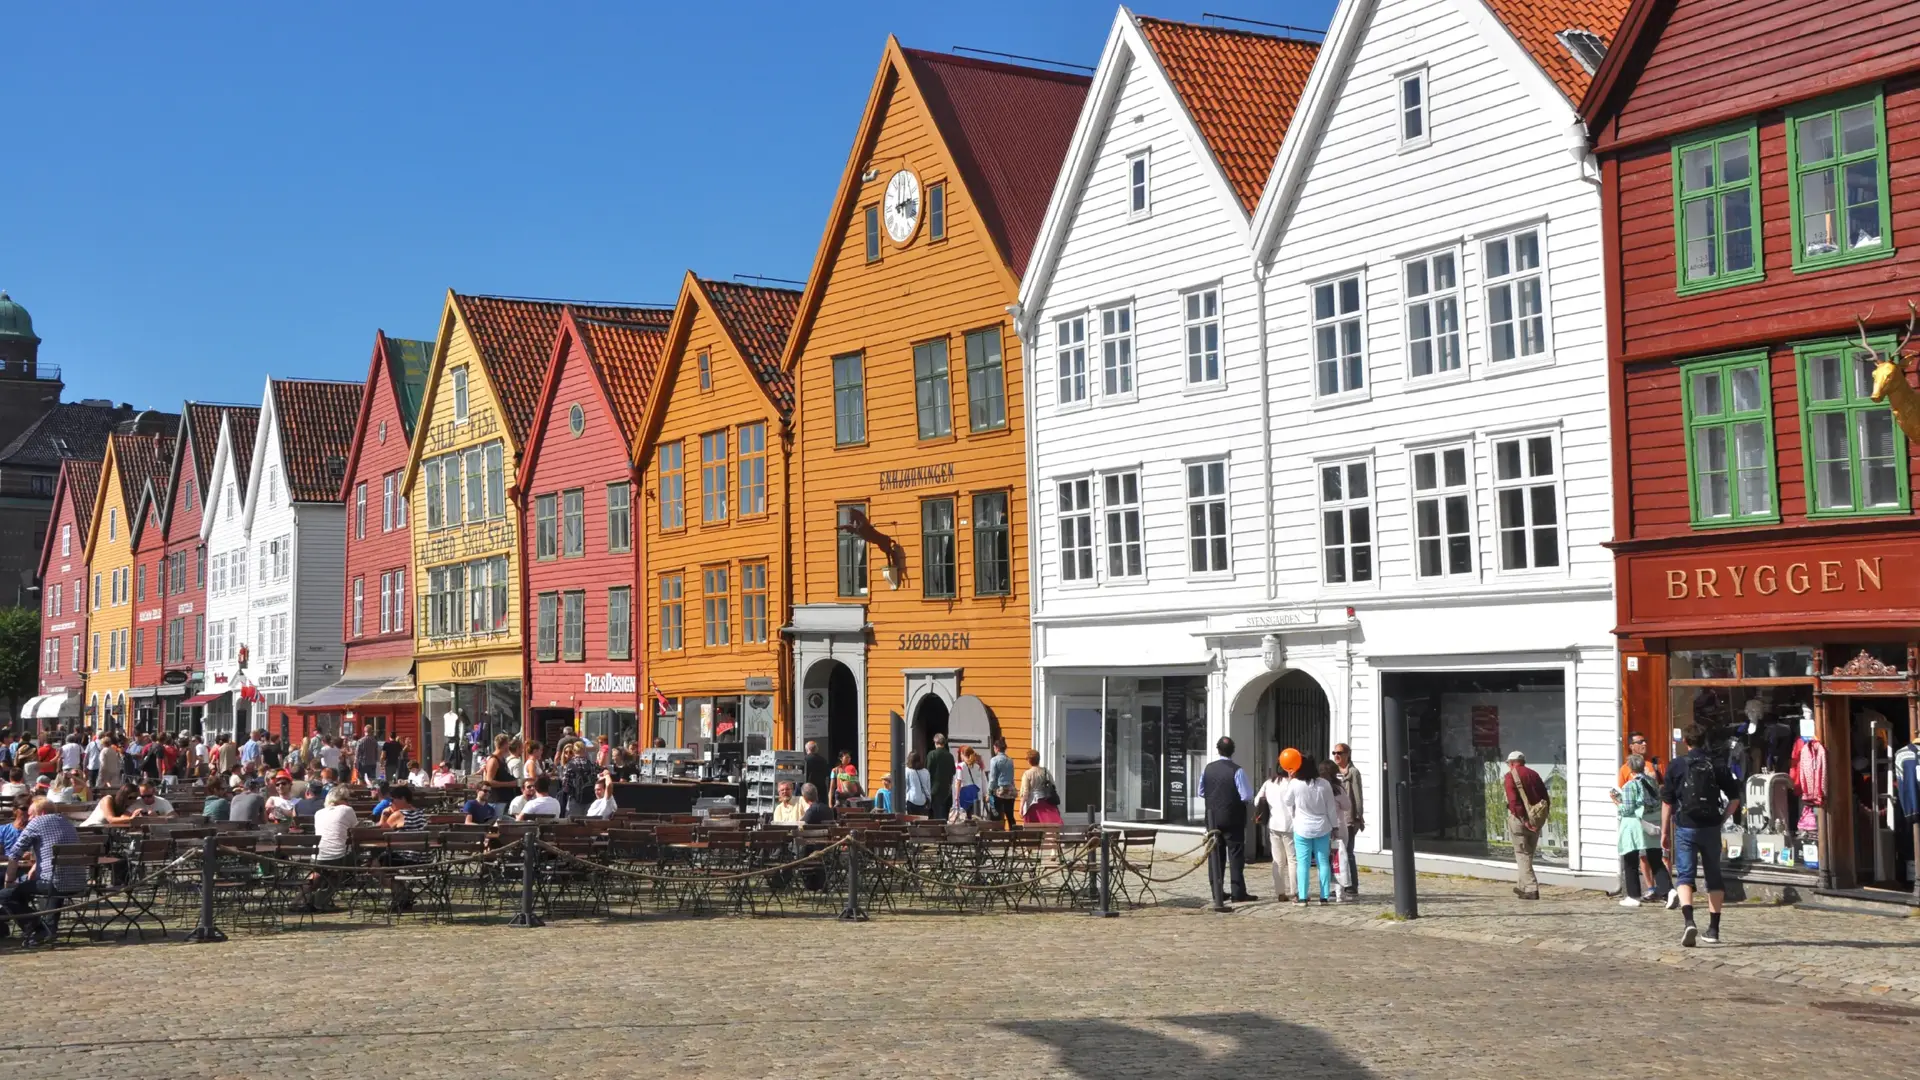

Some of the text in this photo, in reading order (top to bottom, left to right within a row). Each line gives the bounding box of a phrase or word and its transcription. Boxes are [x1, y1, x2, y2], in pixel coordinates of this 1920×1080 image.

[879, 462, 955, 491] ENHJØRNINGEN
[420, 535, 456, 565] ALFRED
[1665, 556, 1884, 600] BRYGGEN
[897, 631, 970, 651] SJØBODEN
[451, 659, 488, 678] SCHJØTT
